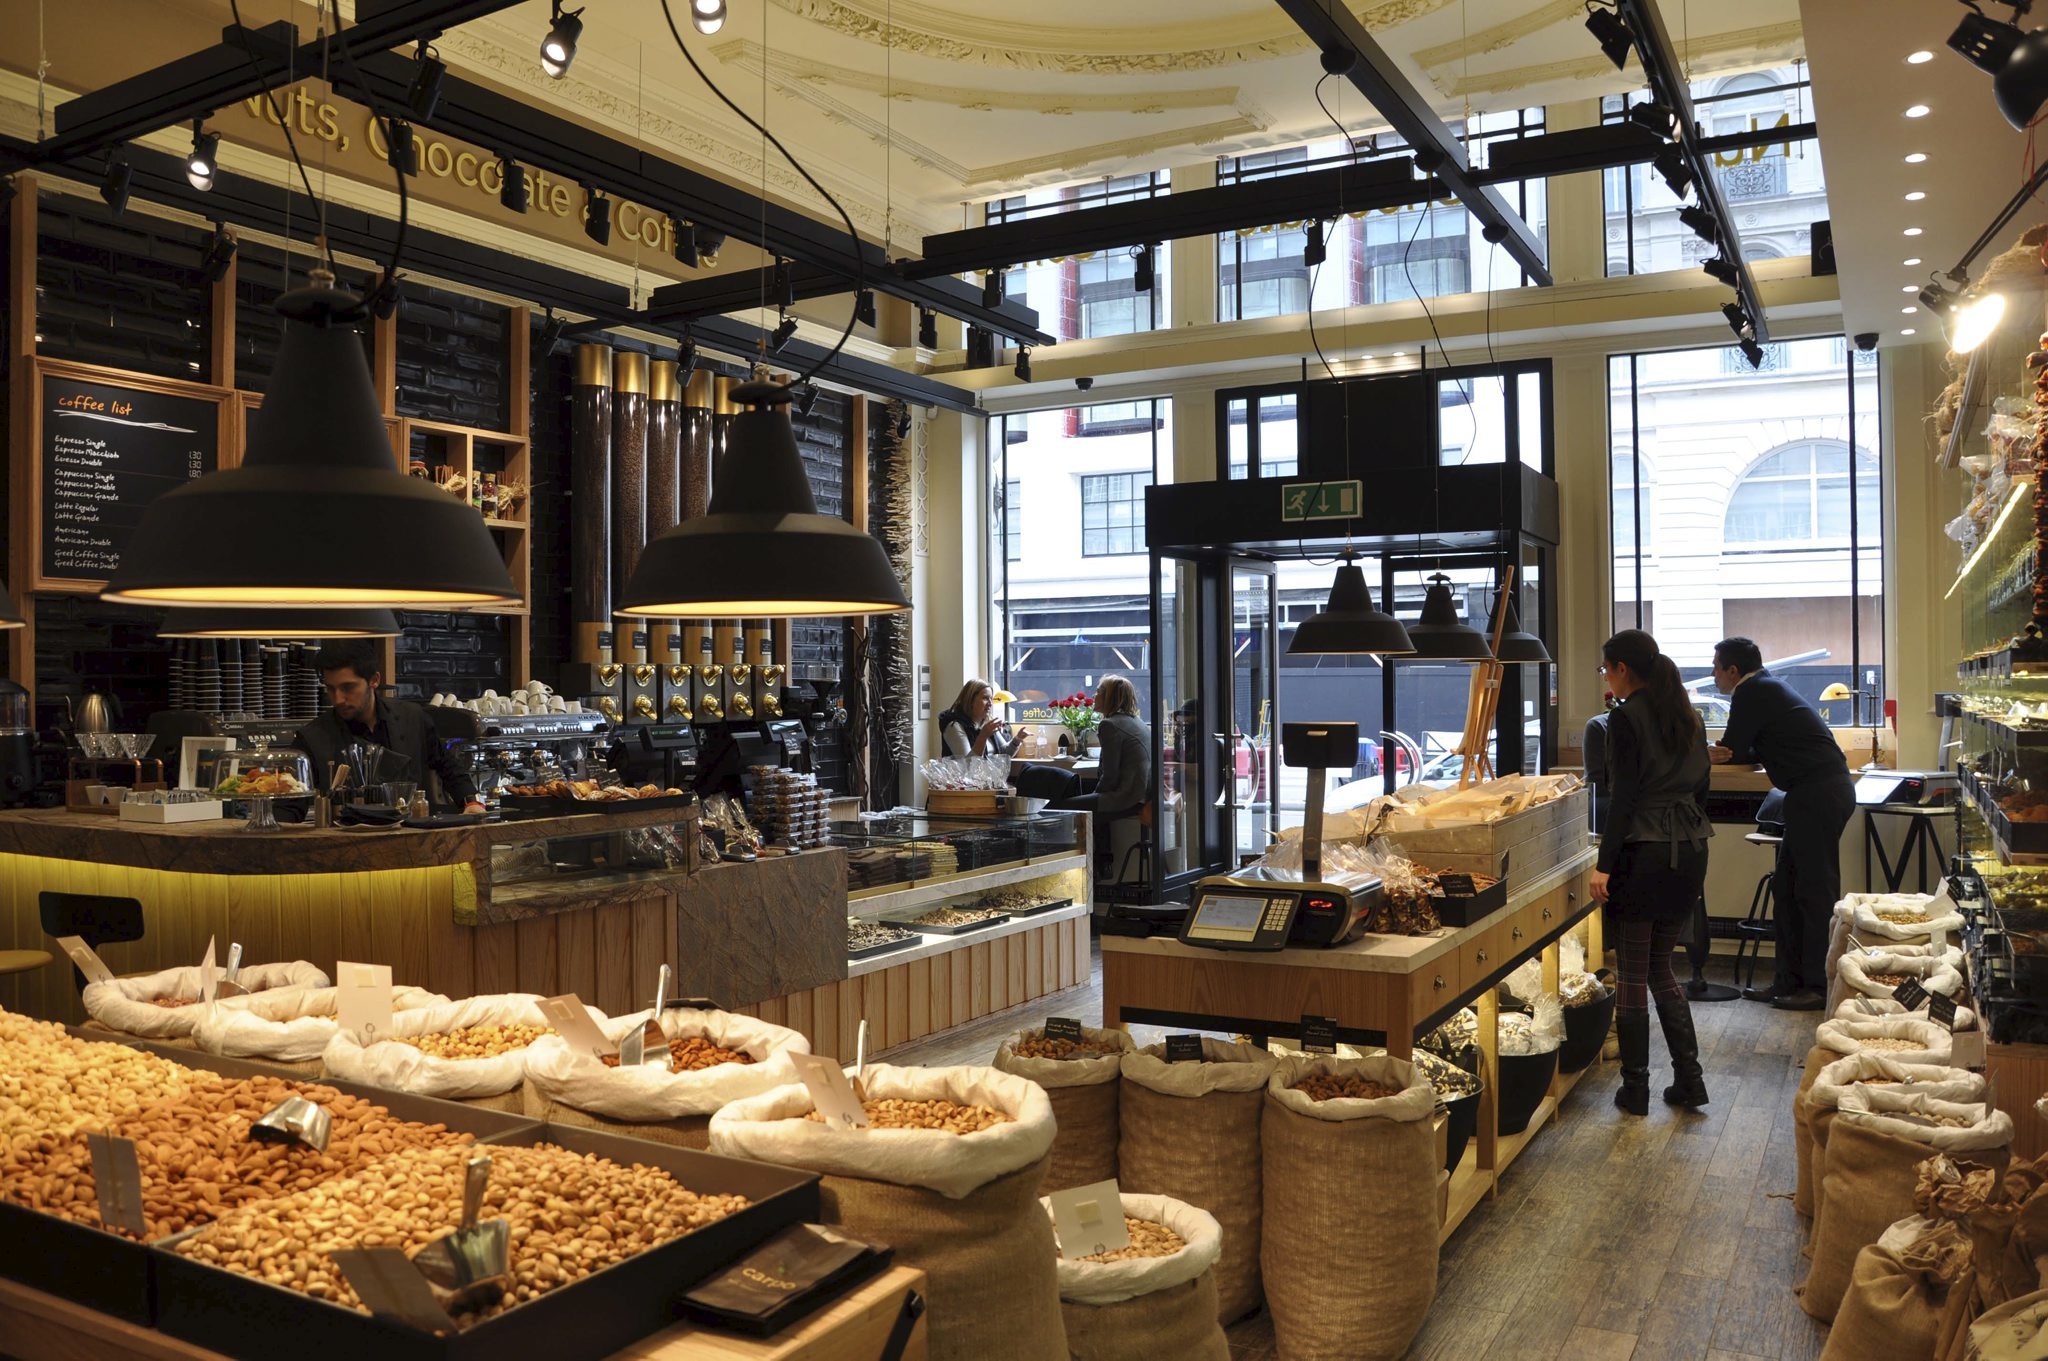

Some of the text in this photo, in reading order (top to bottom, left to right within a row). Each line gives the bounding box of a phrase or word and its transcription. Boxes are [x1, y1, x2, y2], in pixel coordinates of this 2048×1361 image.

[59, 395, 133, 416] coffee list
[55, 434, 106, 449] Espresso Single
[55, 445, 120, 459] Espresso Macchiato
[80, 457, 103, 467] Double
[55, 468, 115, 484] Cappuccino Single
[55, 478, 116, 491] Cappuccino Double
[55, 488, 119, 501] Cappuccino Grande
[55, 502, 99, 514] Latte Regular
[55, 512, 100, 523] Latte Grande
[55, 526, 89, 535] Americano
[55, 536, 112, 546] Americano Double
[55, 550, 120, 563] Greek Coffee Single
[55, 559, 118, 570] Greek Coffee Doubl
[741, 1266, 797, 1291] carpo
